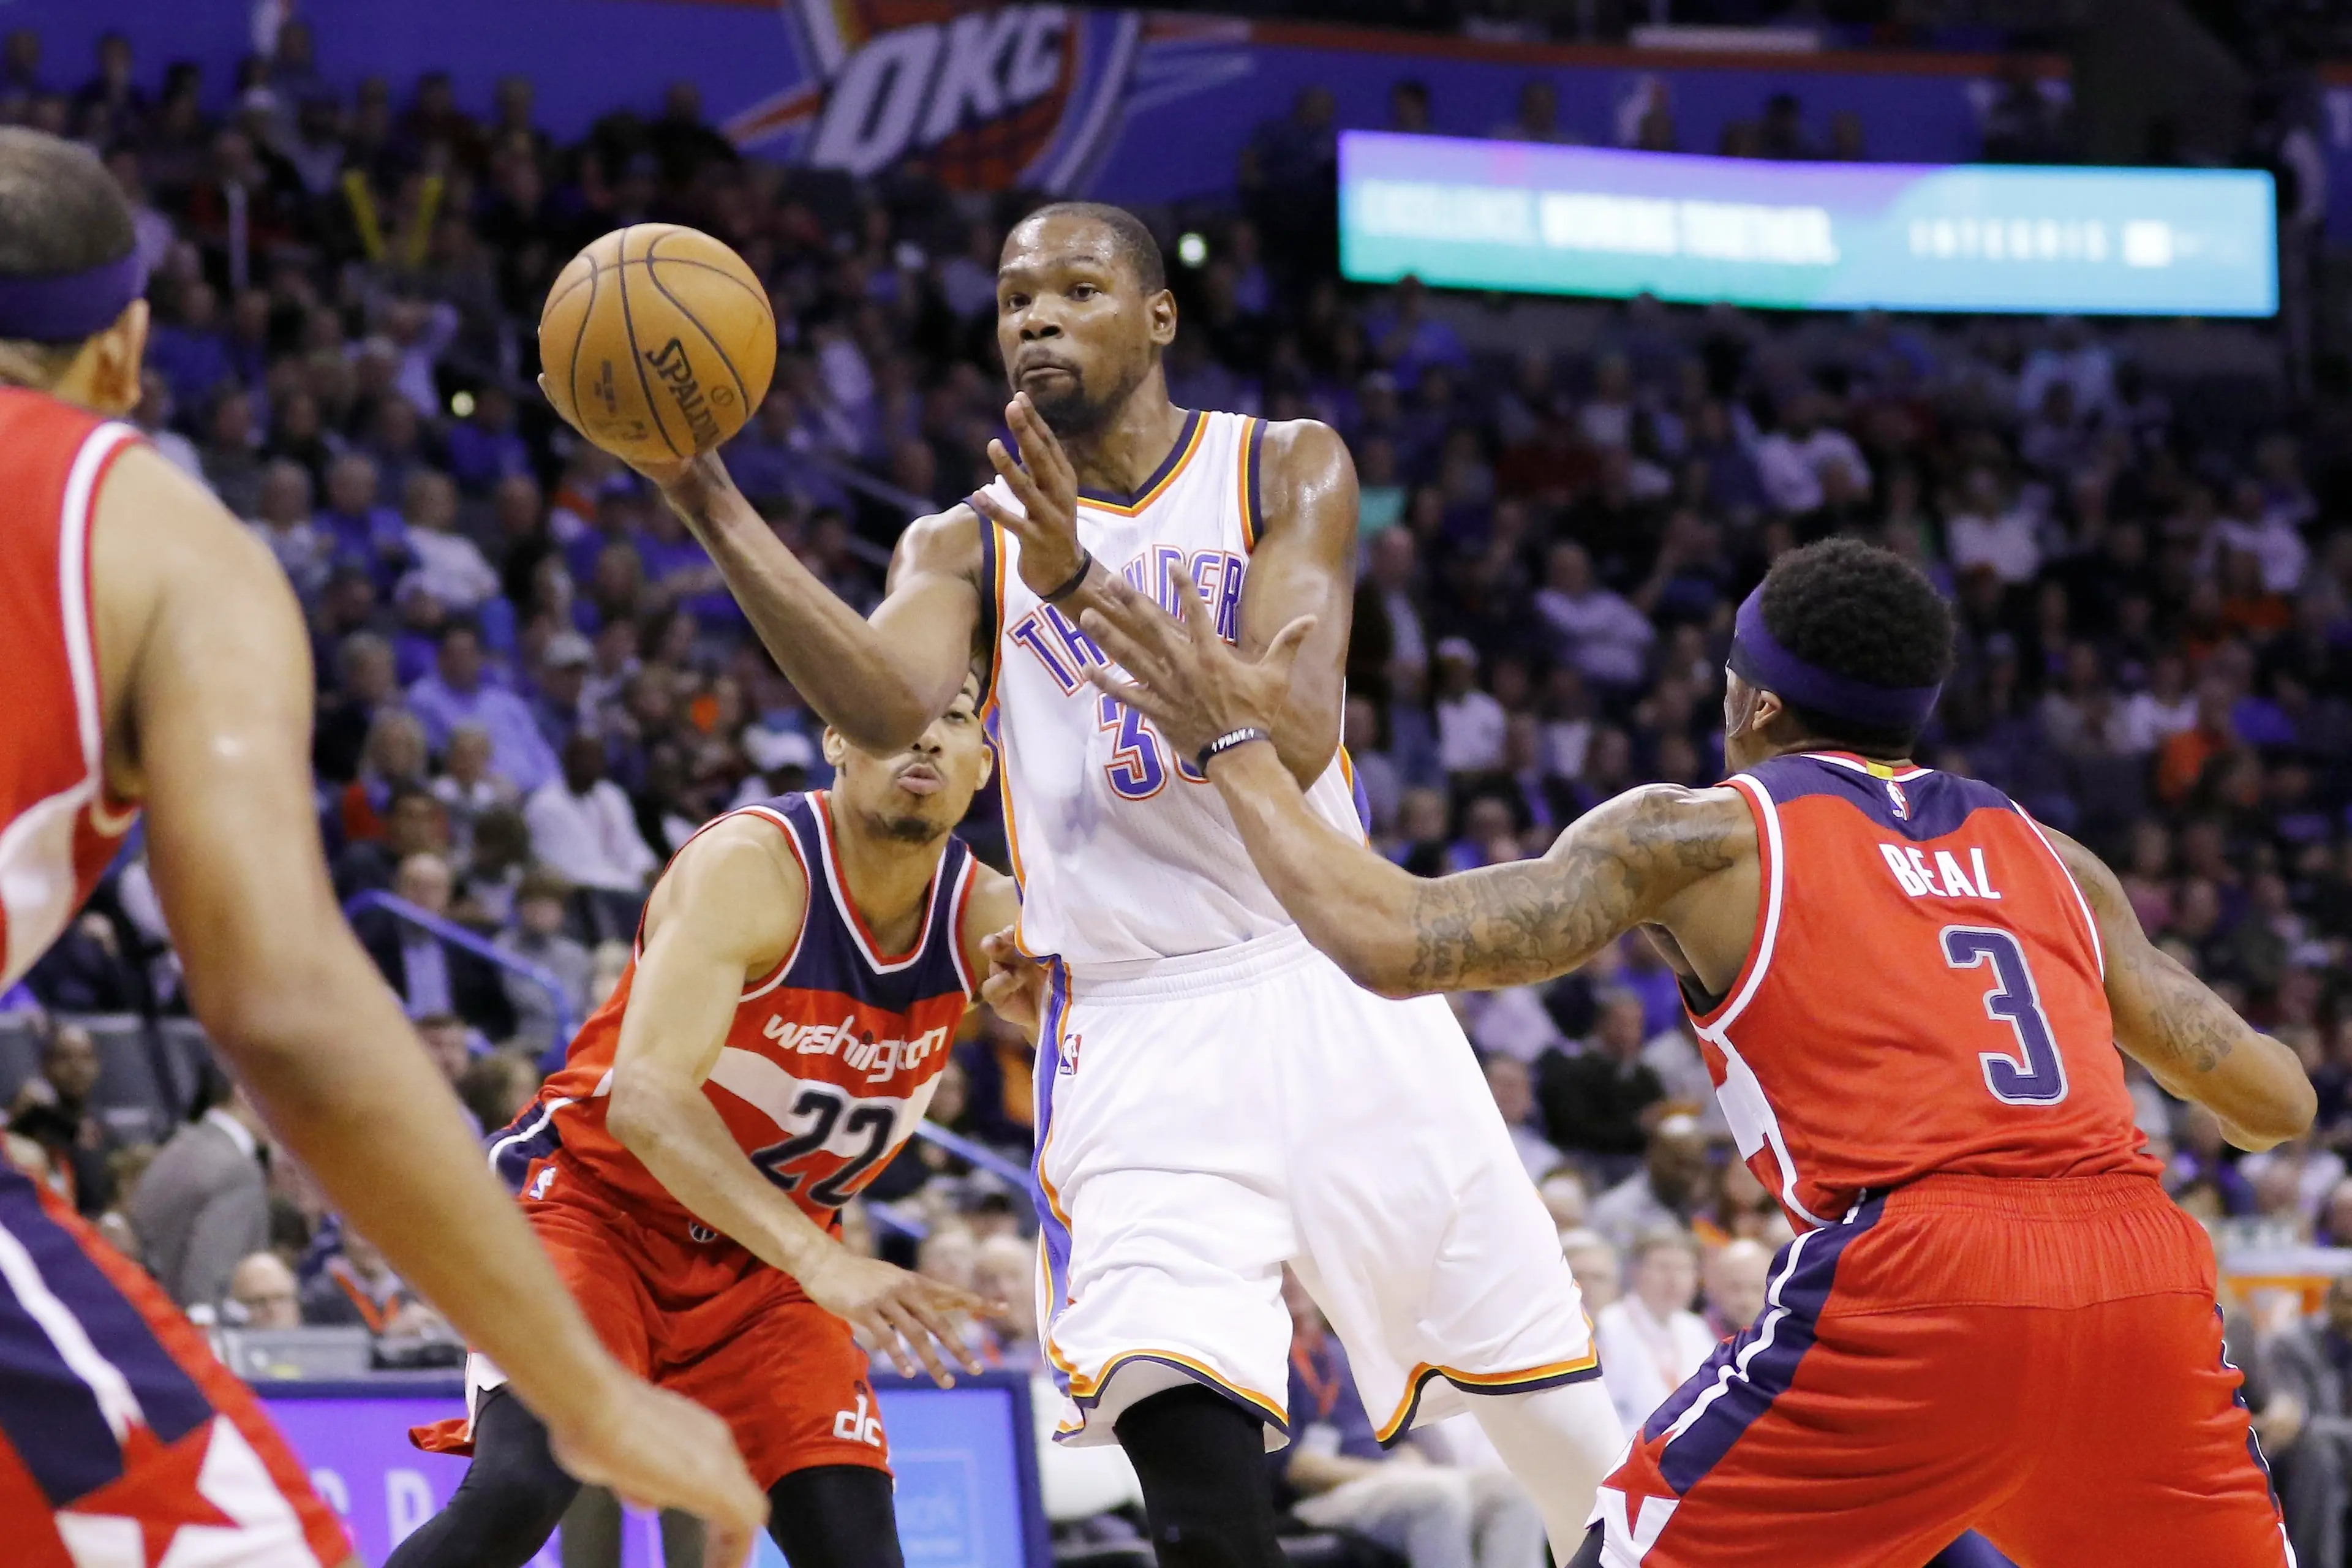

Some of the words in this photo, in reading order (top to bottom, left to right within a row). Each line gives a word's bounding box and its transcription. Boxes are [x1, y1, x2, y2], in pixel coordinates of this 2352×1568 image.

[812, 5, 1071, 176] OKC
[1006, 541, 1246, 697] THDER
[1097, 680, 1211, 801] 3
[1879, 843, 2002, 899] BEAL
[763, 1014, 948, 1083] washington
[1939, 925, 2068, 1106] 3
[750, 1089, 894, 1209] 22
[832, 1392, 882, 1448] dc
